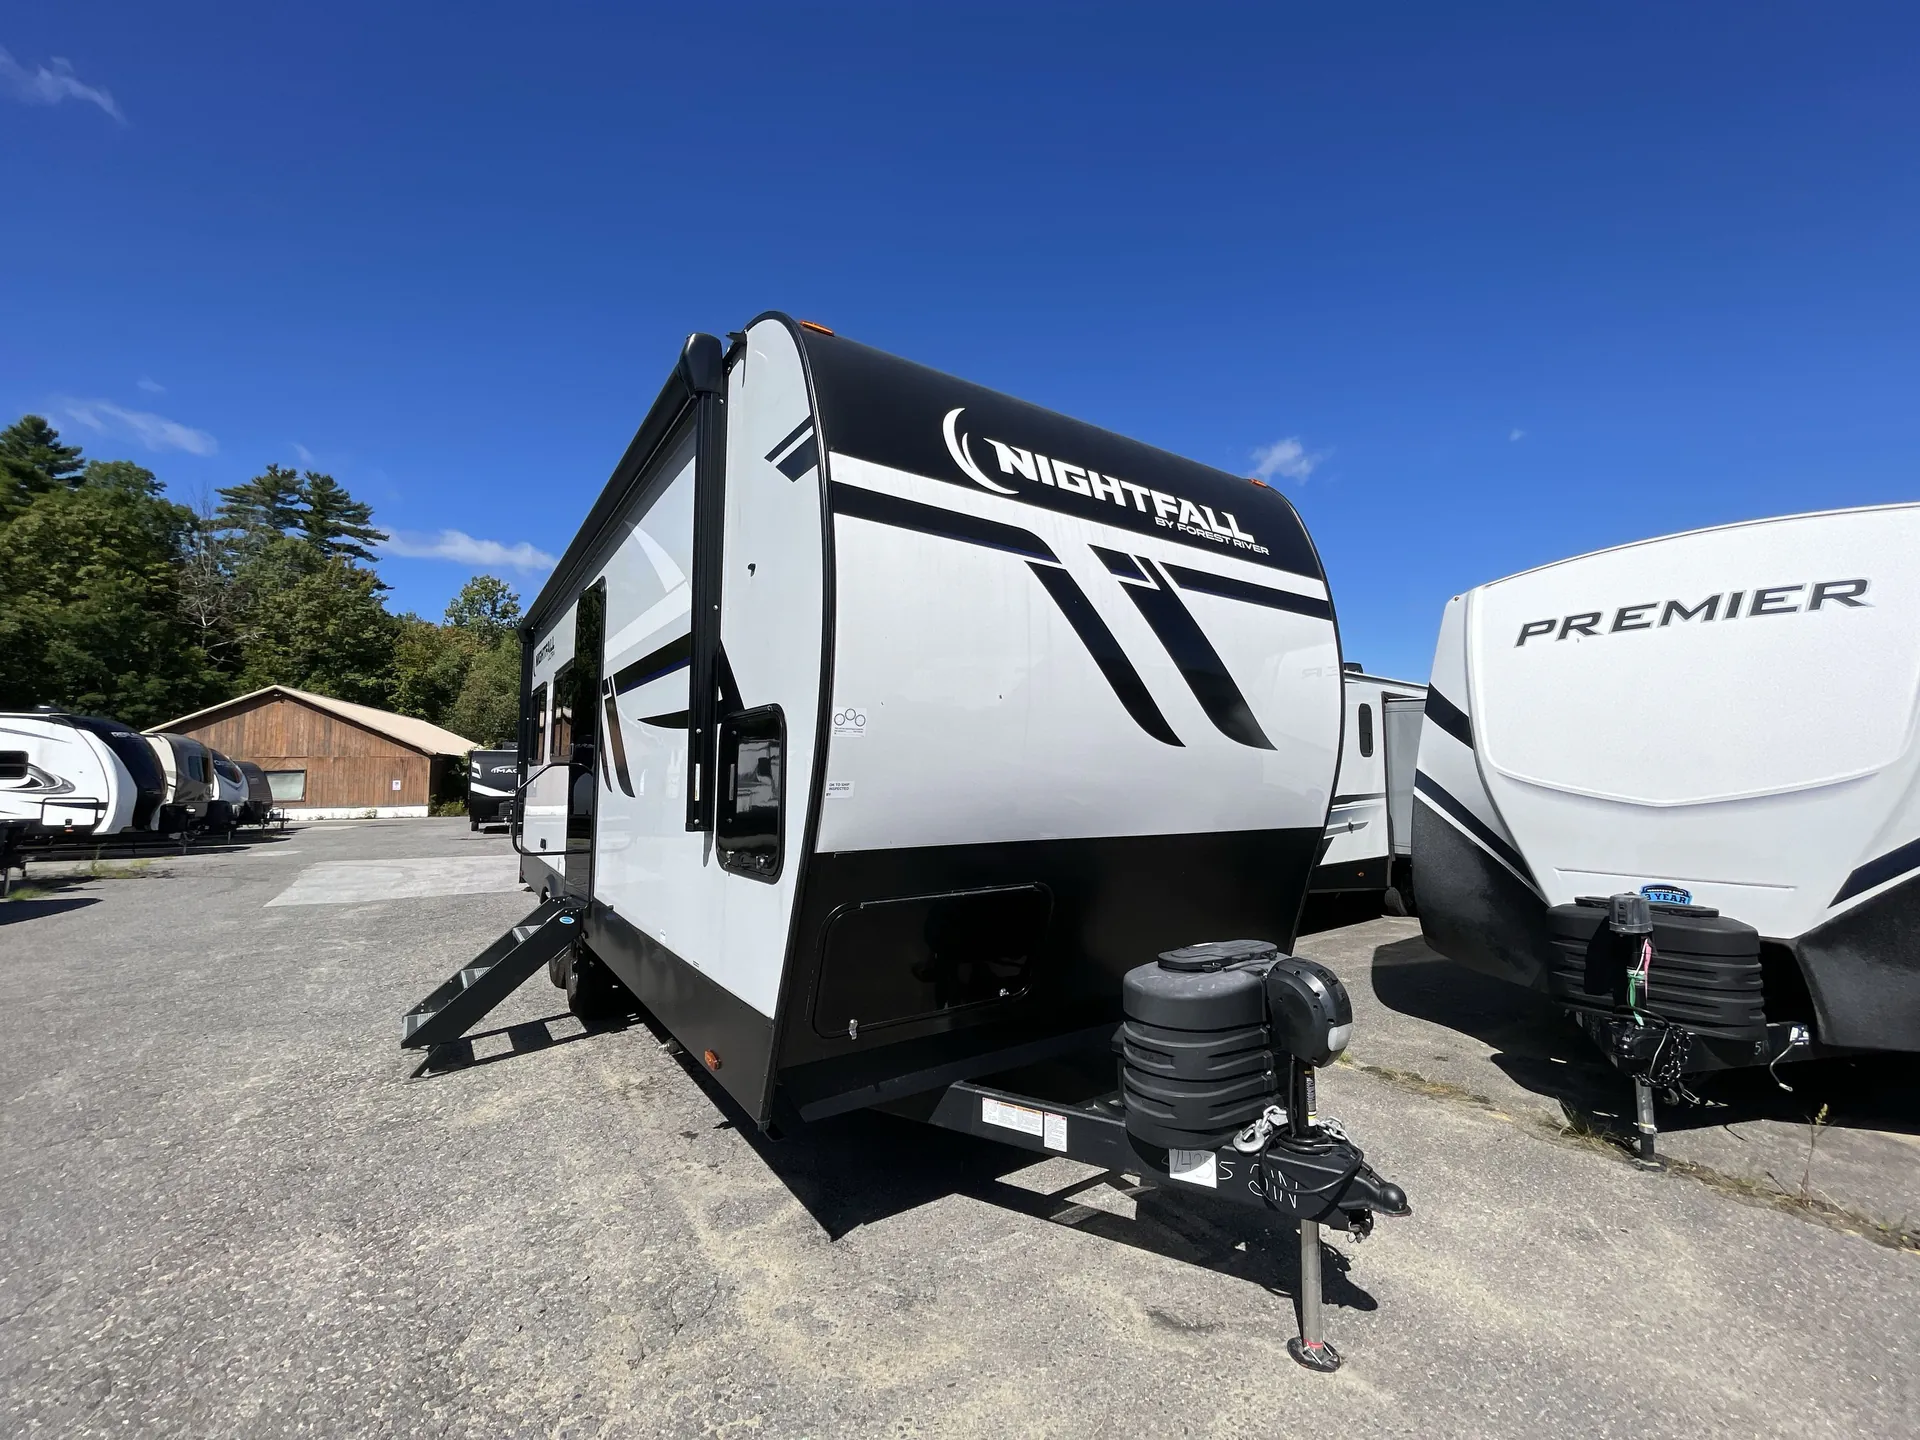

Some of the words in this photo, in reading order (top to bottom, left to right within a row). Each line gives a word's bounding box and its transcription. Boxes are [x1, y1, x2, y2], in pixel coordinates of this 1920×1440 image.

[983, 438, 1255, 543] NIGHTFALL
[1155, 516, 1175, 529] BY
[1177, 522, 1231, 545] FOREST
[1232, 538, 1270, 556] RIVER
[1514, 577, 1874, 648] PREMIER
[1654, 893, 1687, 904] YEAR
